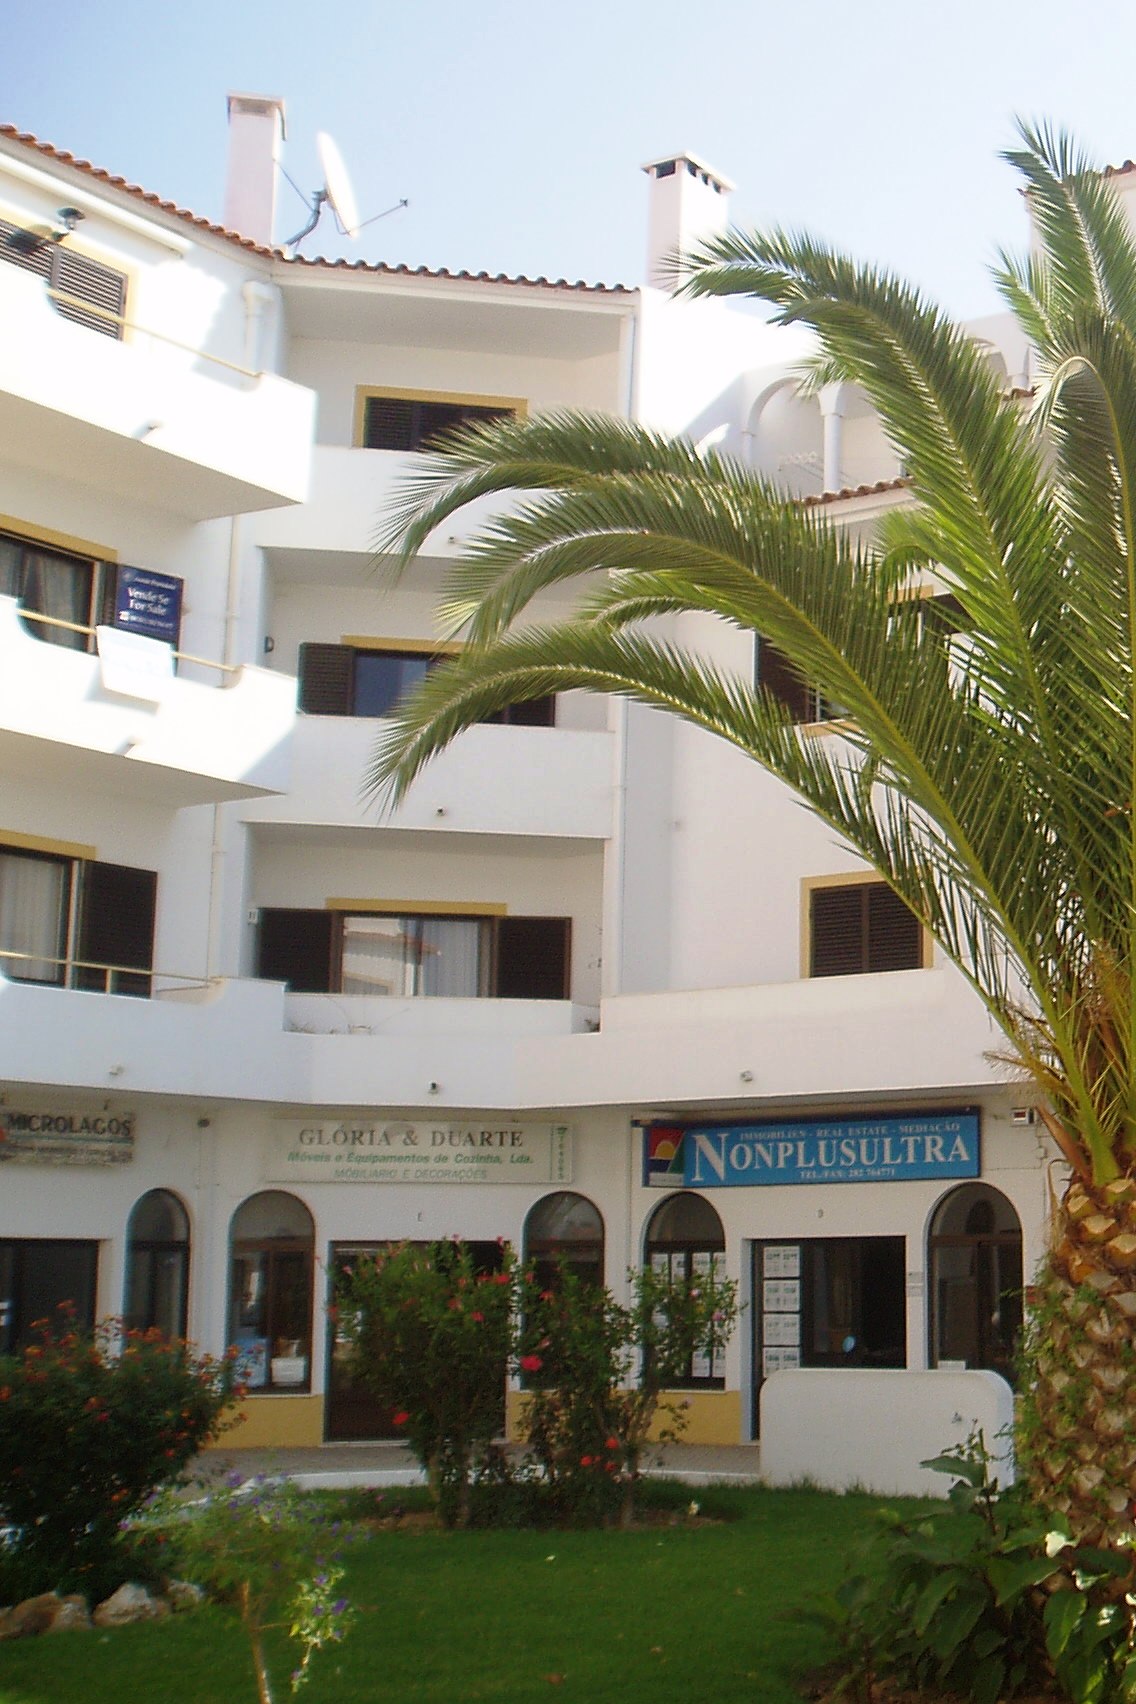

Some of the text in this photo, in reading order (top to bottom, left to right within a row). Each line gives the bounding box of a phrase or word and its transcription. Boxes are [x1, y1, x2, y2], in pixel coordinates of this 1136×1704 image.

[129, 598, 167, 616] For Sale
[8, 1114, 131, 1137] MICROLAGOS
[816, 1128, 842, 1138] REAL
[847, 1126, 888, 1137] ESTATE
[299, 1124, 524, 1147] GLÓRIA & DUARTE
[287, 1151, 331, 1162] Móveis
[335, 1154, 342, 1162] e
[346, 1151, 430, 1164] Equipamentos
[434, 1153, 448, 1164] de
[509, 1154, 534, 1165] Lda.
[690, 1133, 970, 1182] NONPLUSULTRA
[404, 1169, 411, 1179] E
[414, 1168, 487, 1181] DECORAÇÕES
